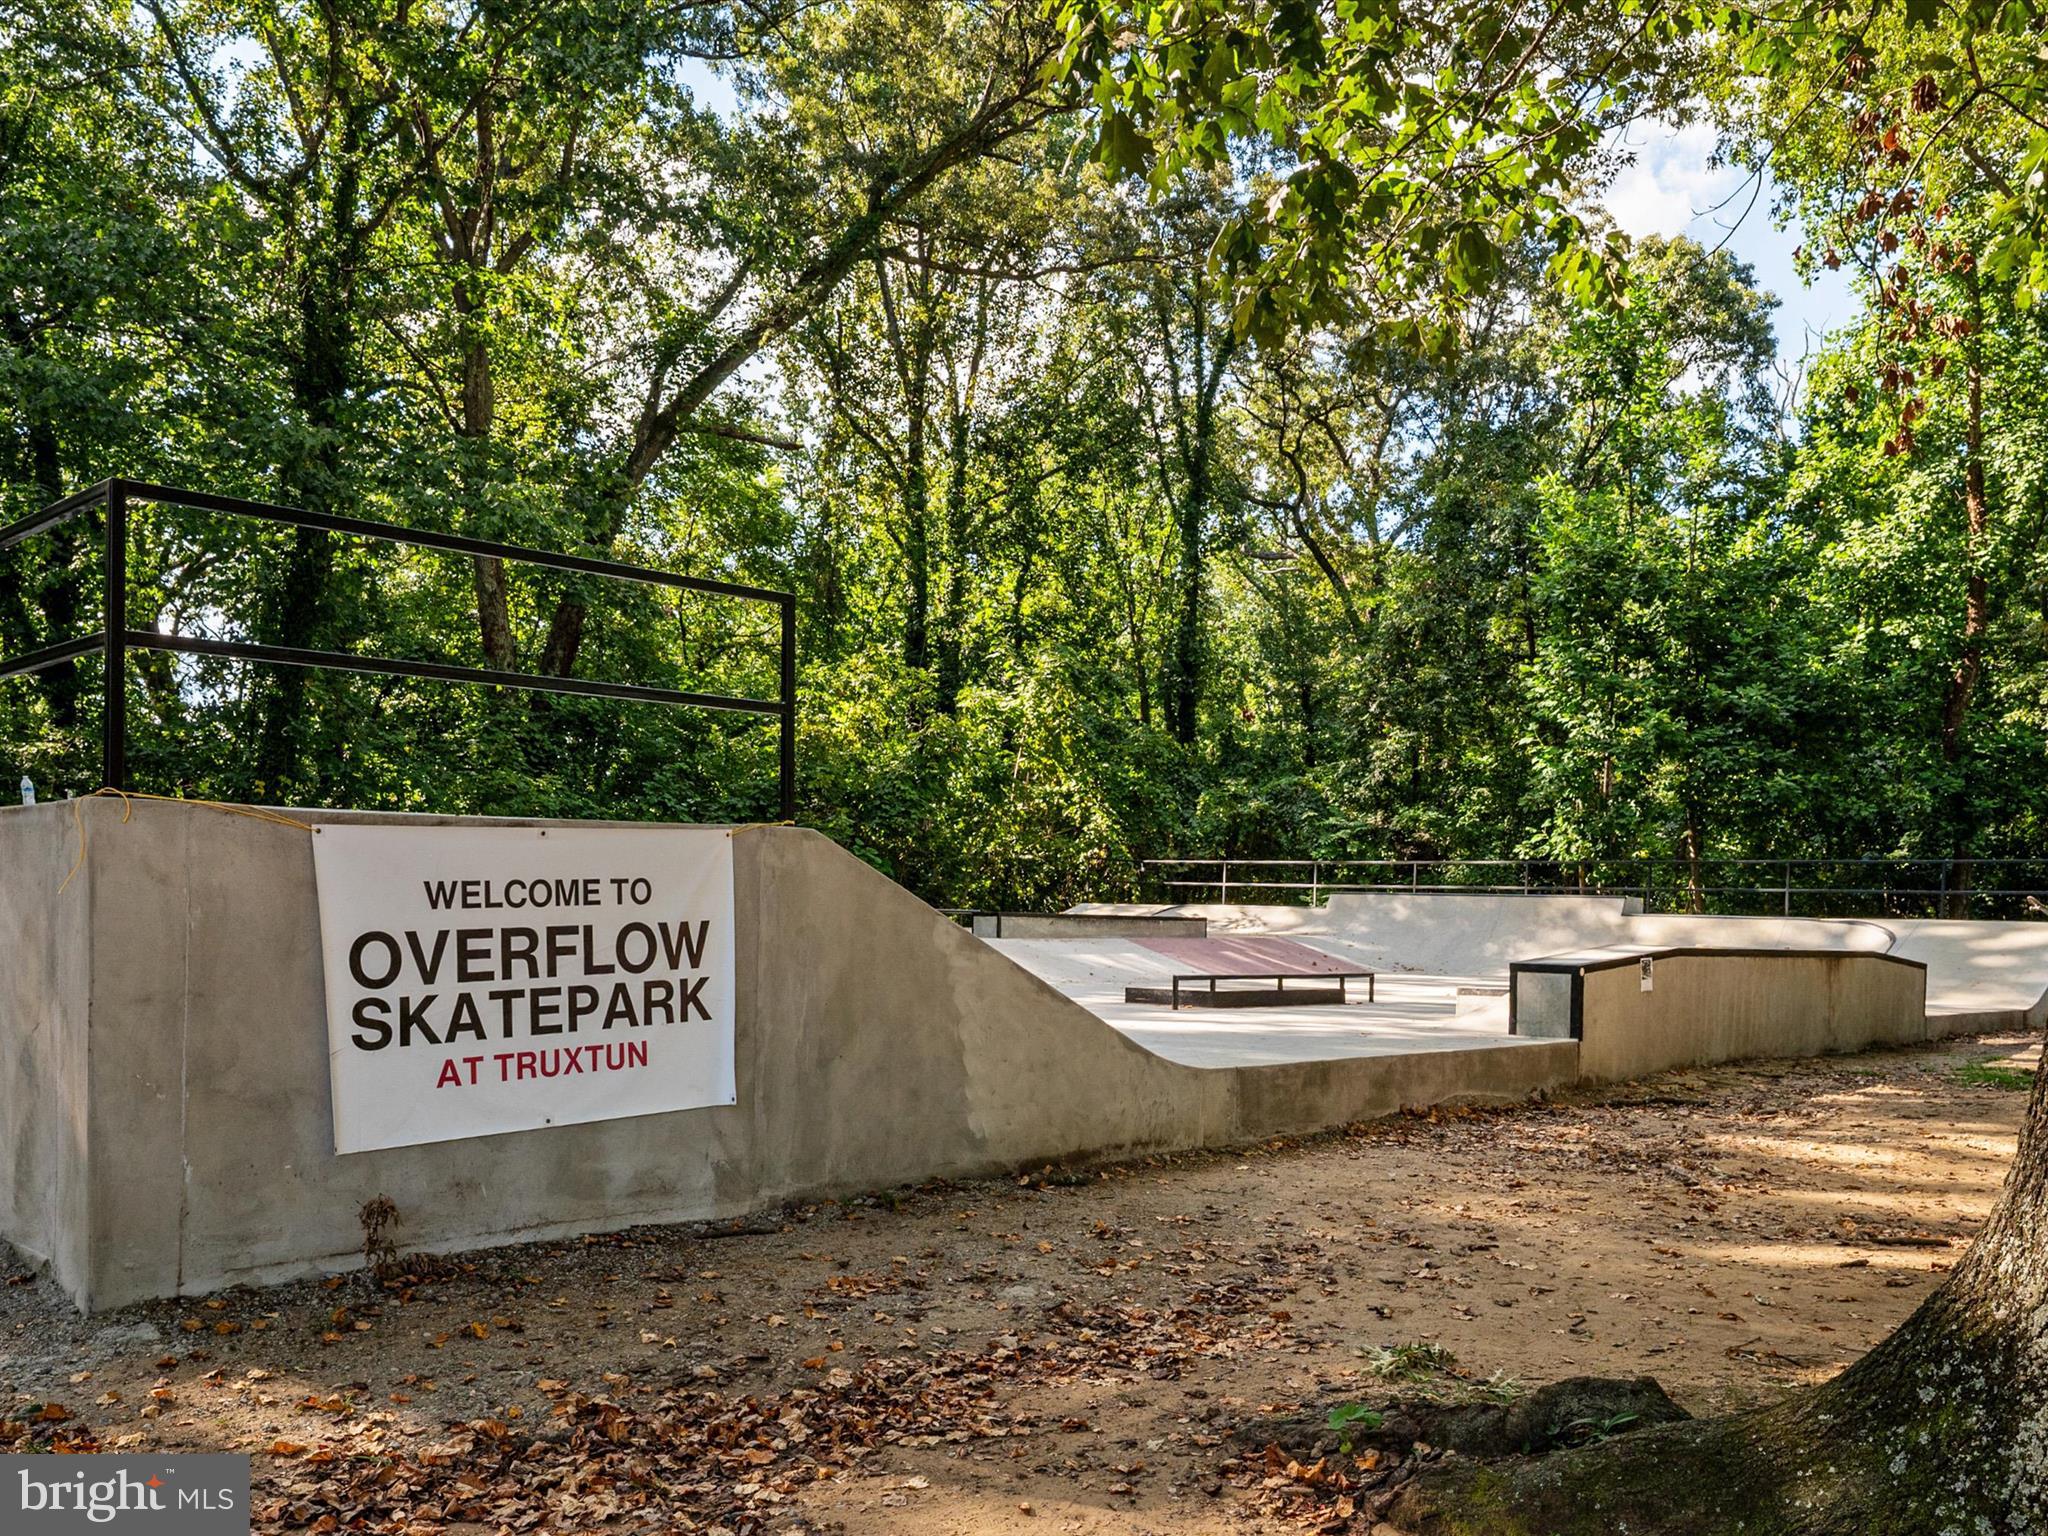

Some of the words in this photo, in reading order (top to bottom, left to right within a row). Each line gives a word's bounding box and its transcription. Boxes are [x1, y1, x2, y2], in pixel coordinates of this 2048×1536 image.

[423, 878, 601, 910] WELCOME
[610, 878, 652, 905] TO
[348, 920, 710, 989] OVERFLOW
[351, 976, 713, 1052] SKATEPARK
[436, 1056, 484, 1089] AT
[493, 1040, 648, 1082] TRUXTUN
